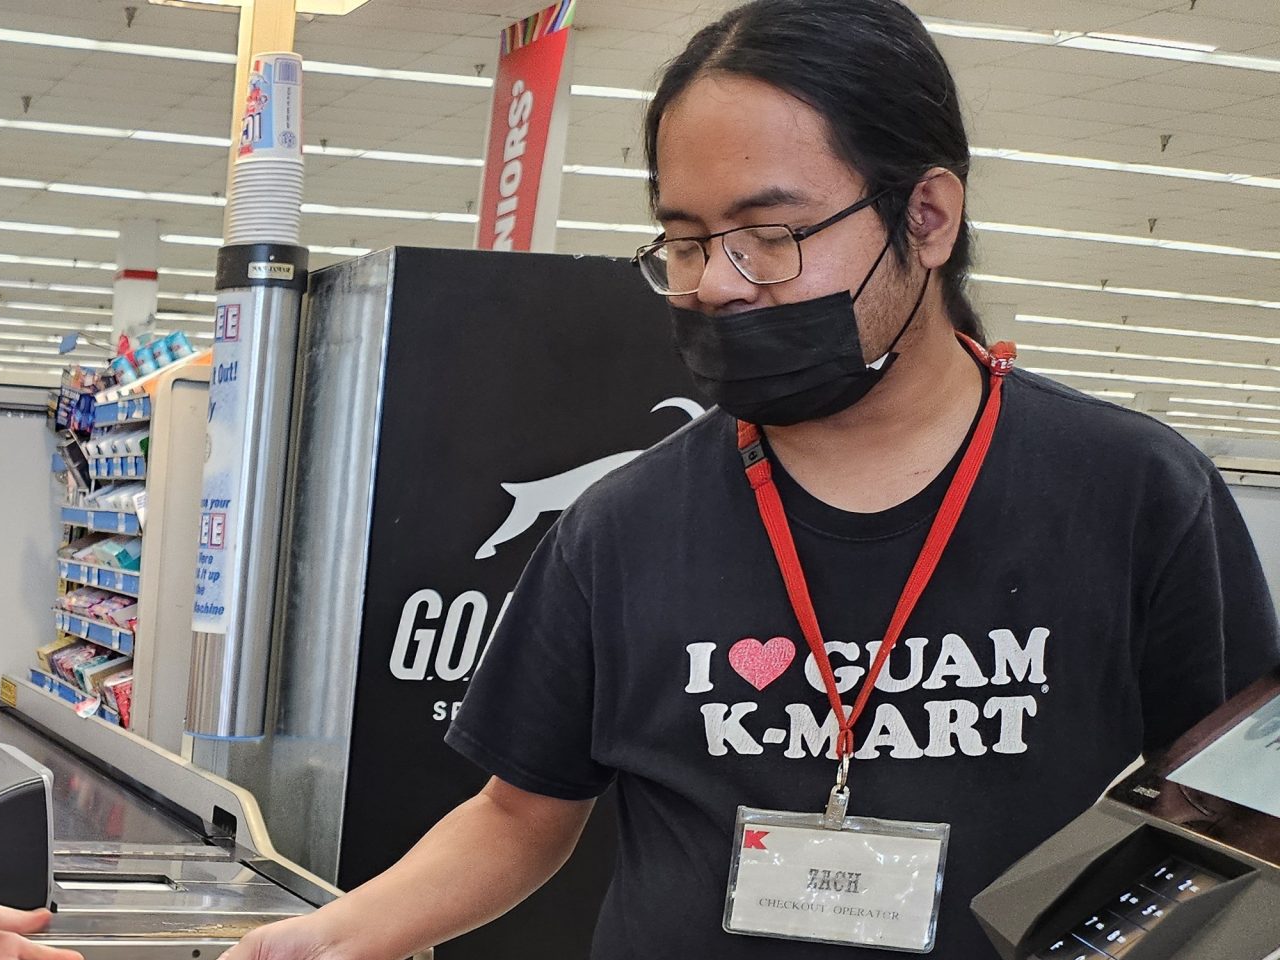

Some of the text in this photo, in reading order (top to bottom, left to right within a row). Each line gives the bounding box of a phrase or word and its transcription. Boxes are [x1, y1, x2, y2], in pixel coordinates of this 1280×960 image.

[218, 361, 238, 383] Out!
[389, 589, 514, 682] G.O.
[684, 627, 1051, 695] I GUAM
[700, 695, 1037, 760] K-MART
[743, 829, 770, 850] K
[807, 868, 862, 894] ZACH
[759, 898, 900, 921] CHECKOUT OPERATOR
